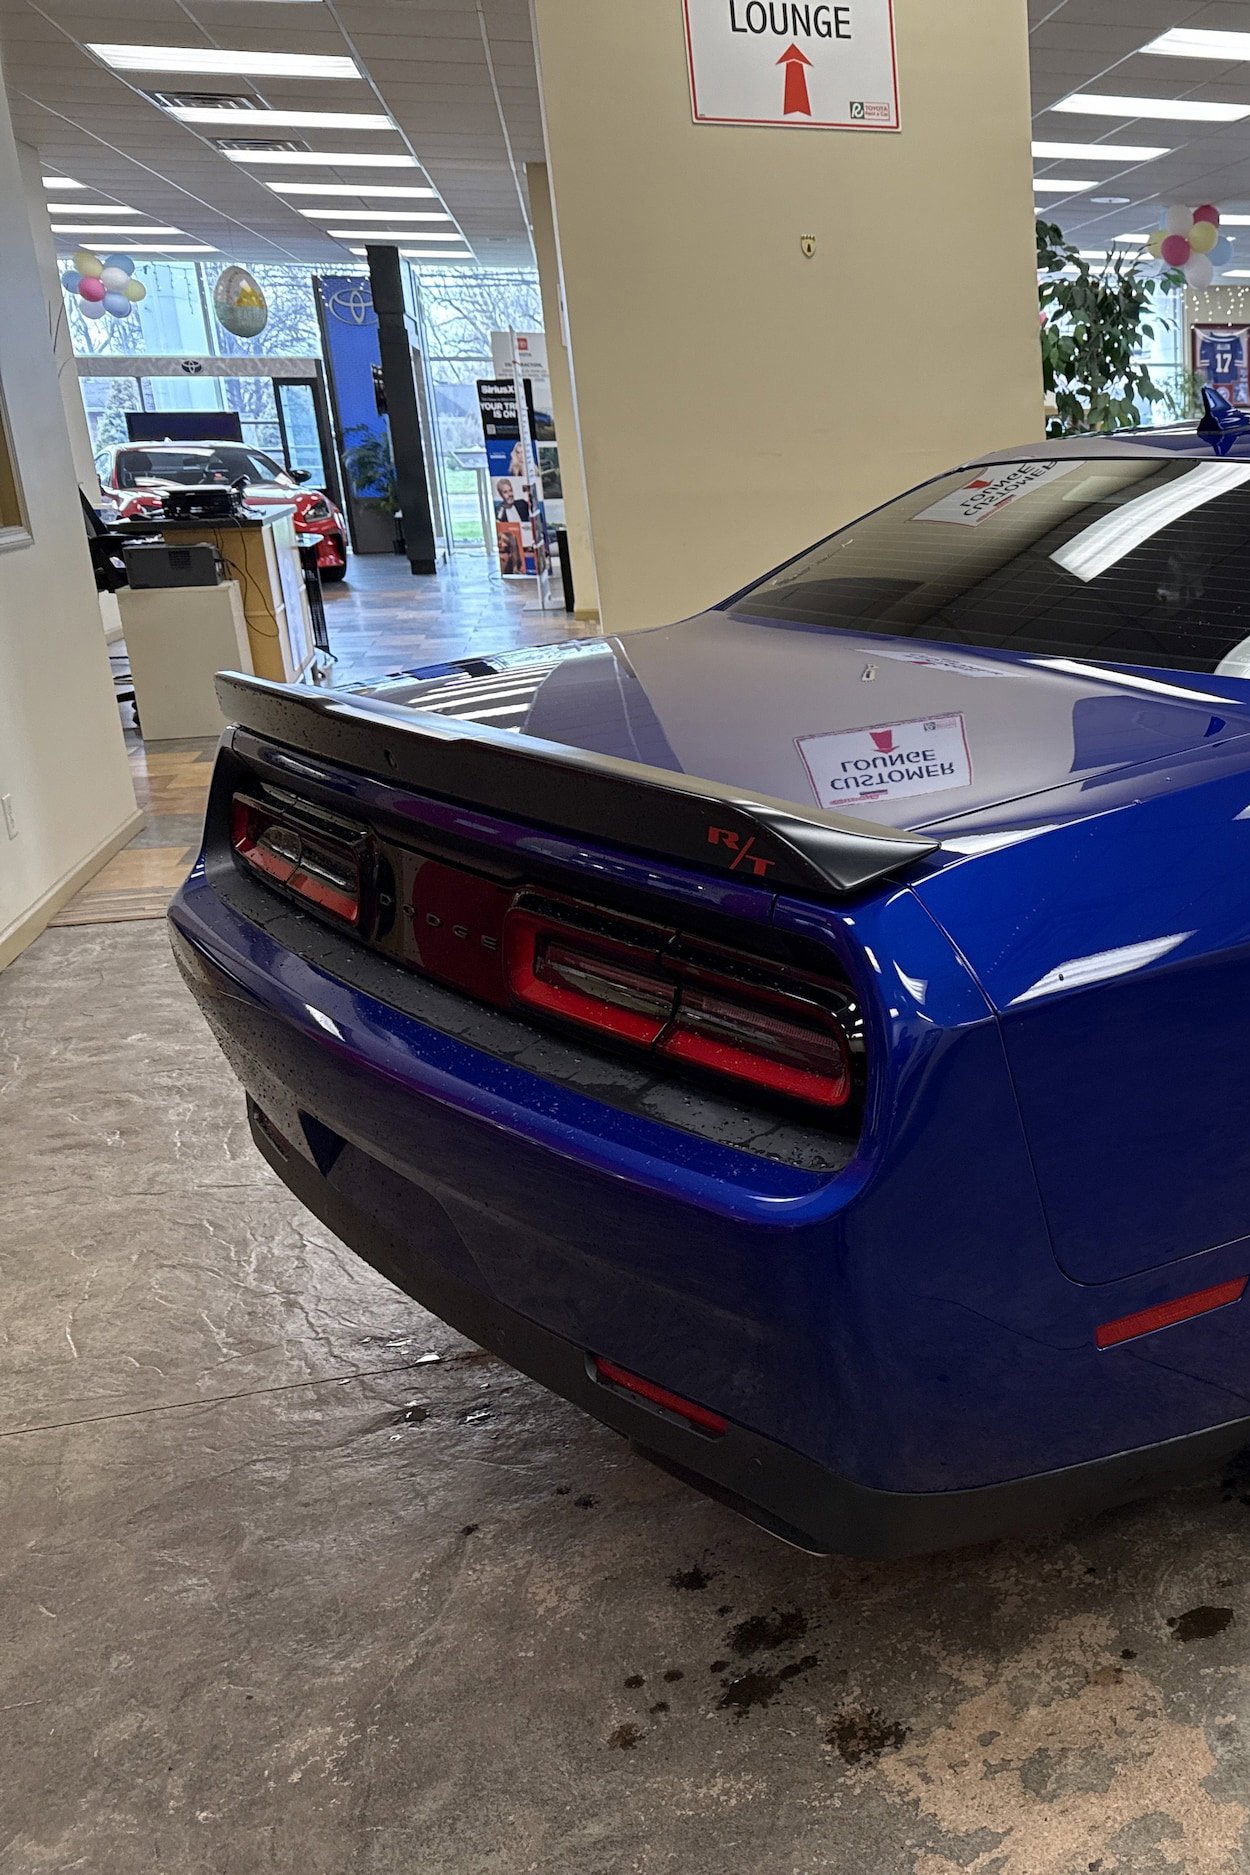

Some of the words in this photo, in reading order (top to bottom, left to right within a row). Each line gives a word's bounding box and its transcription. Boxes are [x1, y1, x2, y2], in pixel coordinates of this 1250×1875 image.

[729, 0, 852, 39] LOUNGE
[1215, 353, 1232, 373] 17
[481, 384, 515, 394] SiriusX
[480, 402, 503, 411] YOUR
[493, 410, 502, 419] IS
[503, 410, 516, 419] ON
[708, 826, 776, 876] R/T
[379, 893, 497, 951] DODGE
